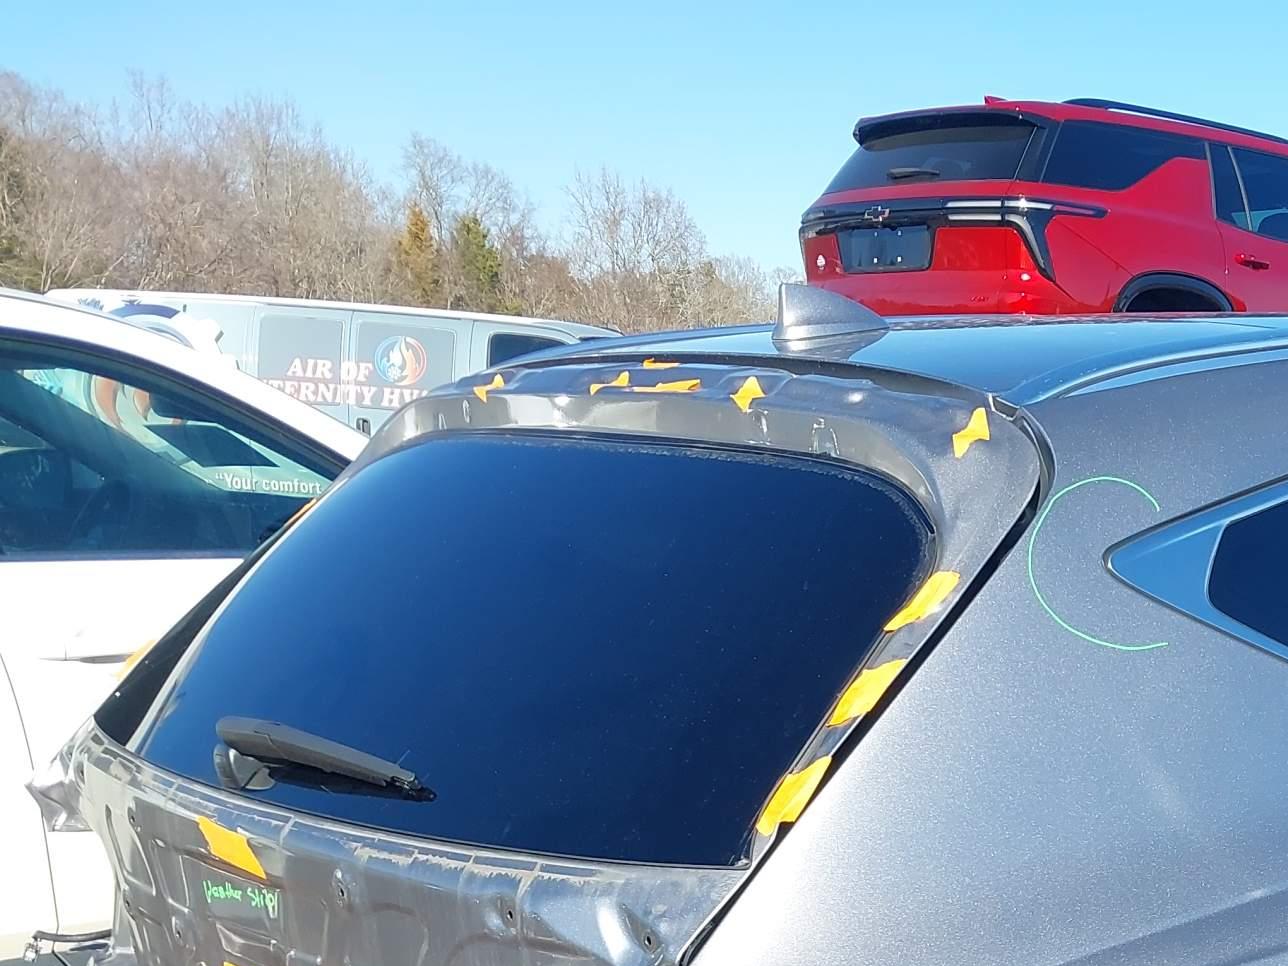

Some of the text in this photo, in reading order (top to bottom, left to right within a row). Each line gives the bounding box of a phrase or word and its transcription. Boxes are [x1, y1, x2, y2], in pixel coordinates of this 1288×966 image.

[286, 357, 374, 382] AIR OF
[263, 378, 428, 408] TERNITY HV
[262, 478, 322, 494] comfort
